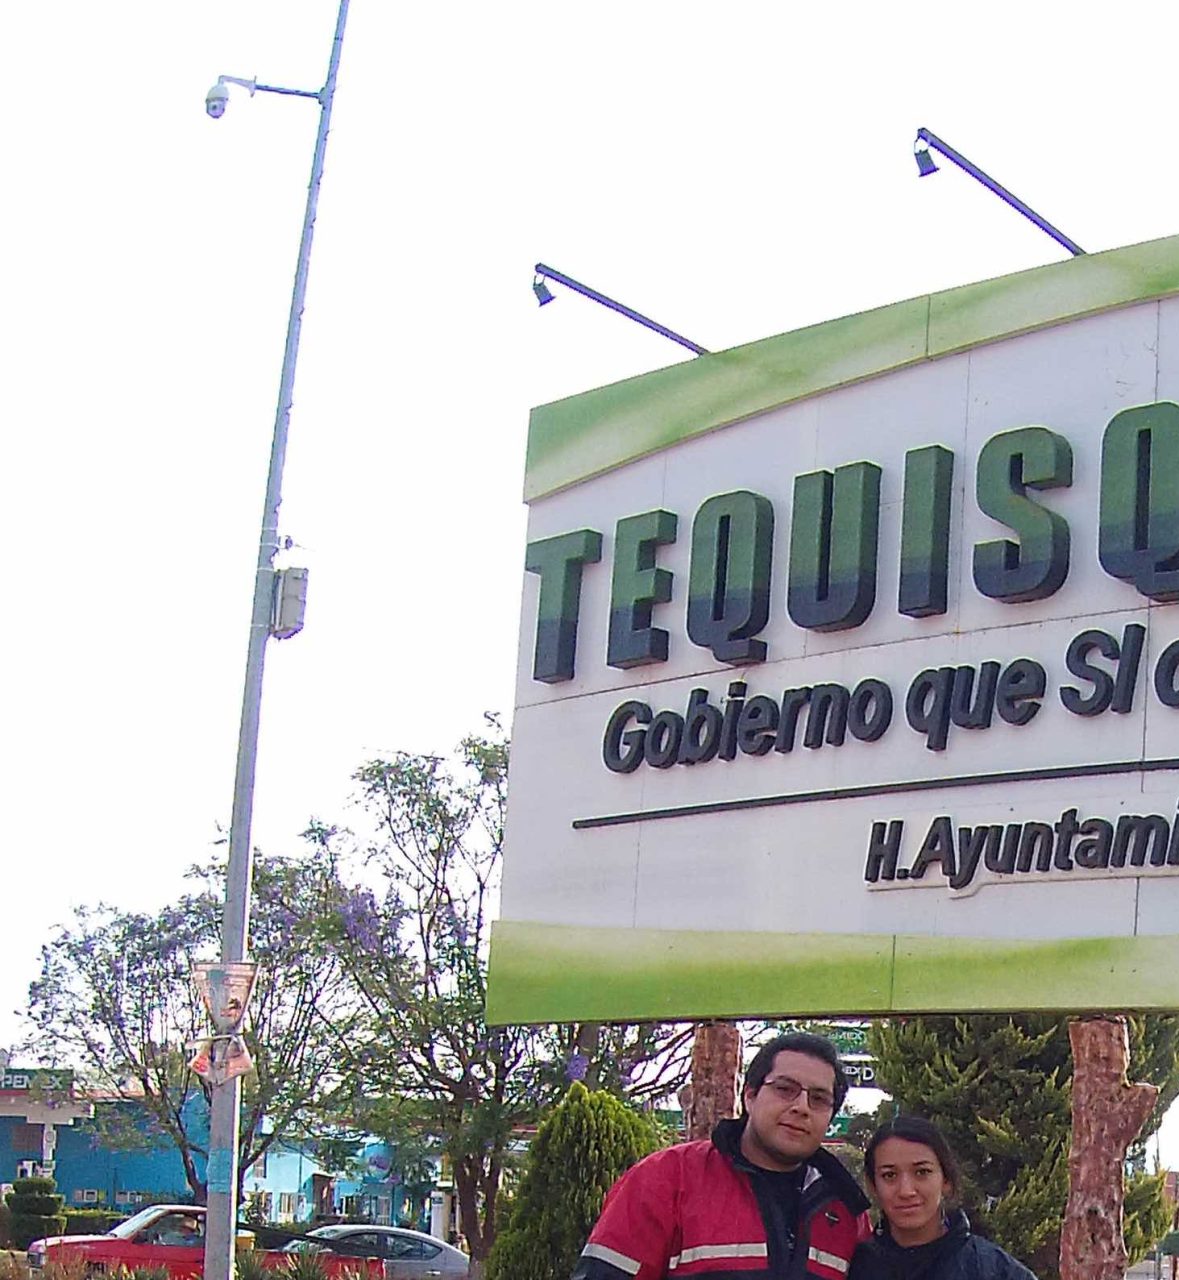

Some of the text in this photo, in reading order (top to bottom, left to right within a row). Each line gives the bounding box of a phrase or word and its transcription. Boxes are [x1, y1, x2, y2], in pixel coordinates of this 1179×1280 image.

[602, 680, 894, 774] Gobierno
[905, 657, 1048, 752] que
[1058, 621, 1147, 718] SI
